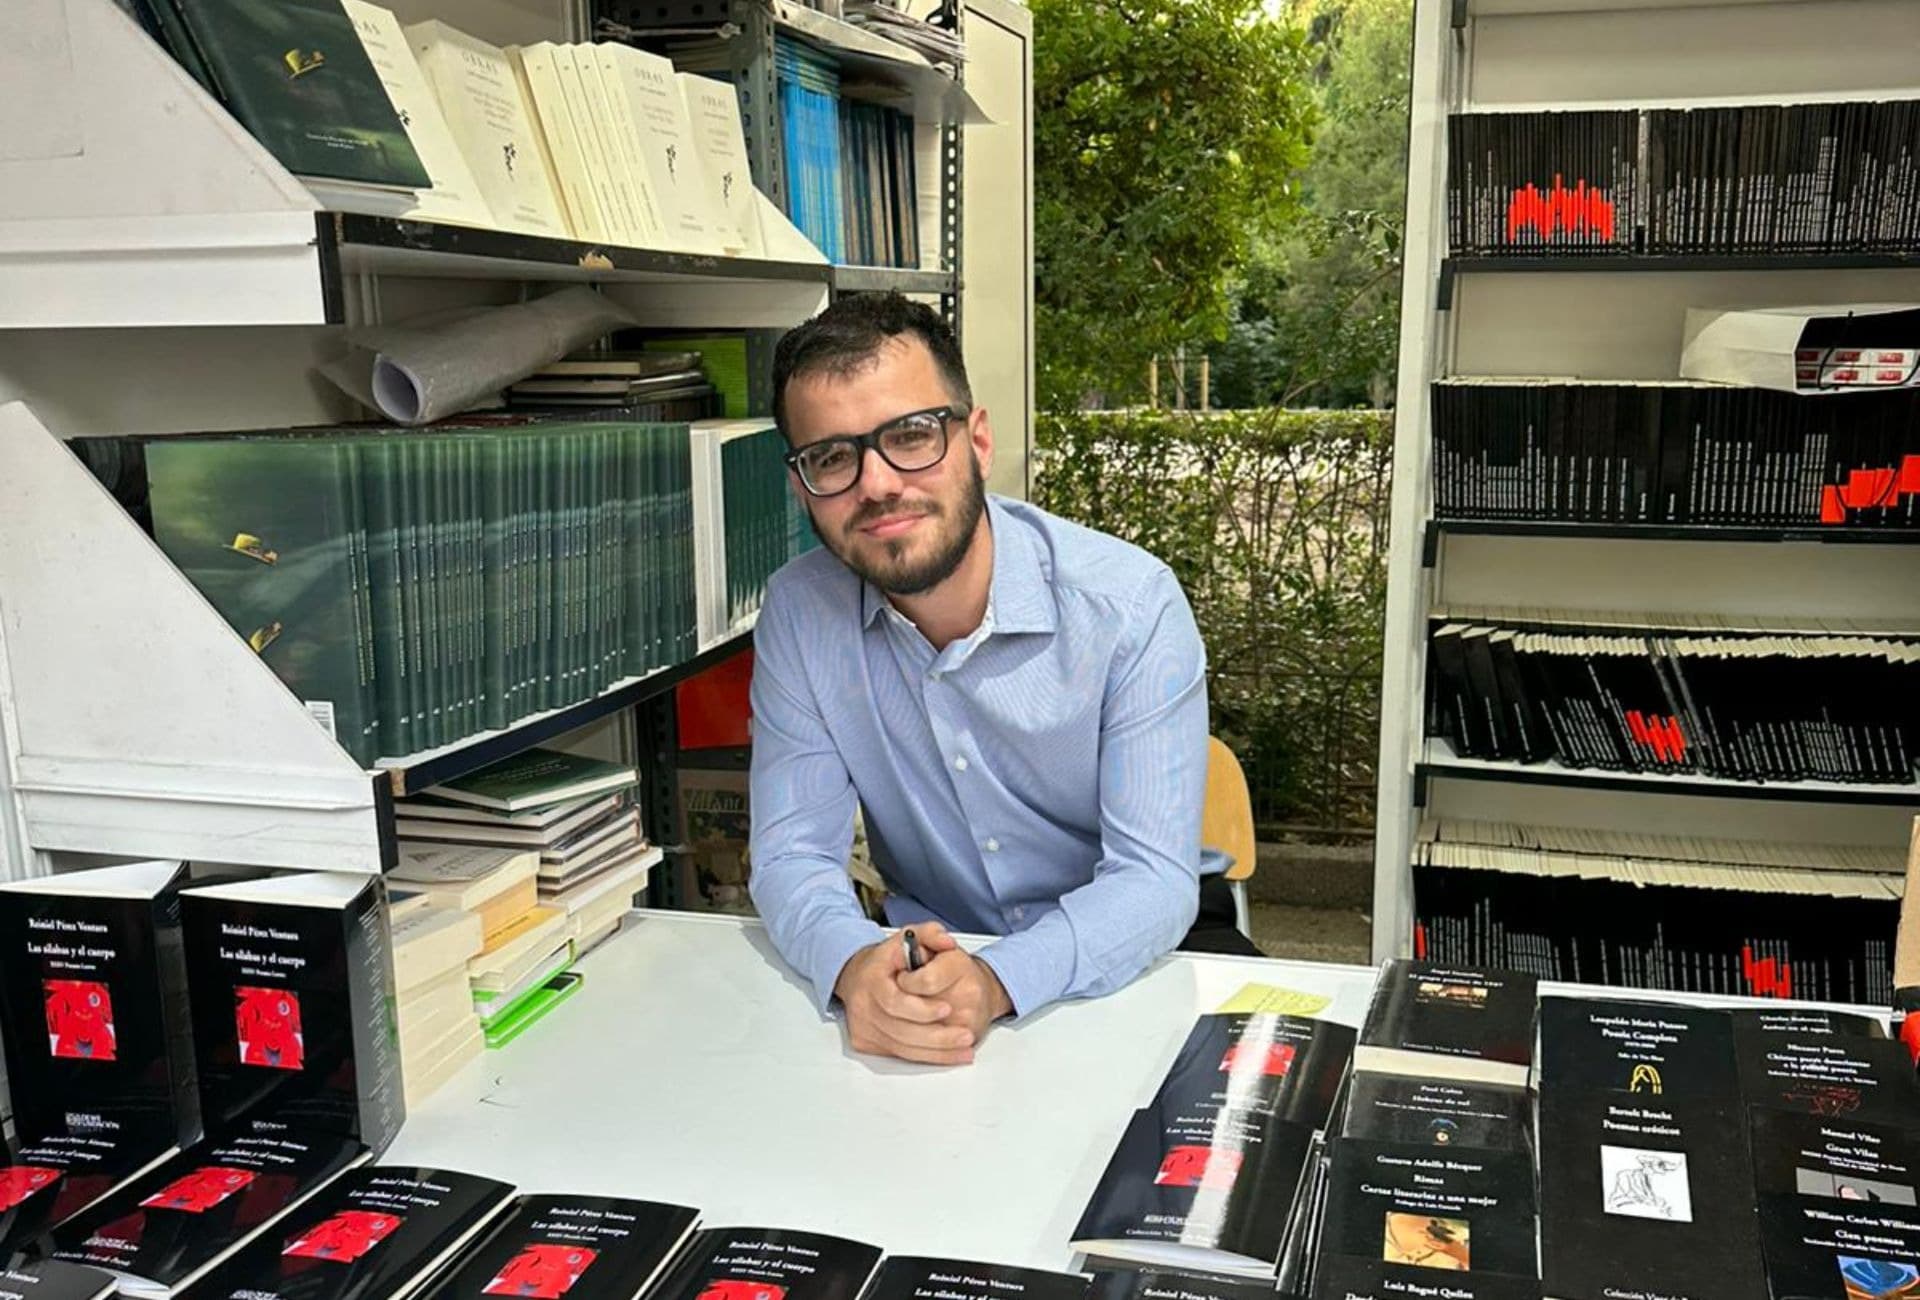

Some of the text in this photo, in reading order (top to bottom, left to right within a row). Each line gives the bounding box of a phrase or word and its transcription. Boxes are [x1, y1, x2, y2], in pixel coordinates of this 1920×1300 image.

[1414, 1174, 1444, 1184] Rimas
[1360, 1184, 1391, 1195] Cartas
[1468, 1196, 1498, 1206] mujer
[1804, 1209, 1844, 1221] William
[531, 1221, 547, 1229] Las
[598, 1228, 629, 1237] cuerpo
[1835, 1229, 1904, 1246] Cien poemas
[771, 1260, 782, 1268] el
[782, 1263, 815, 1274] cuerpo
[1384, 1280, 1405, 1291] Luis
